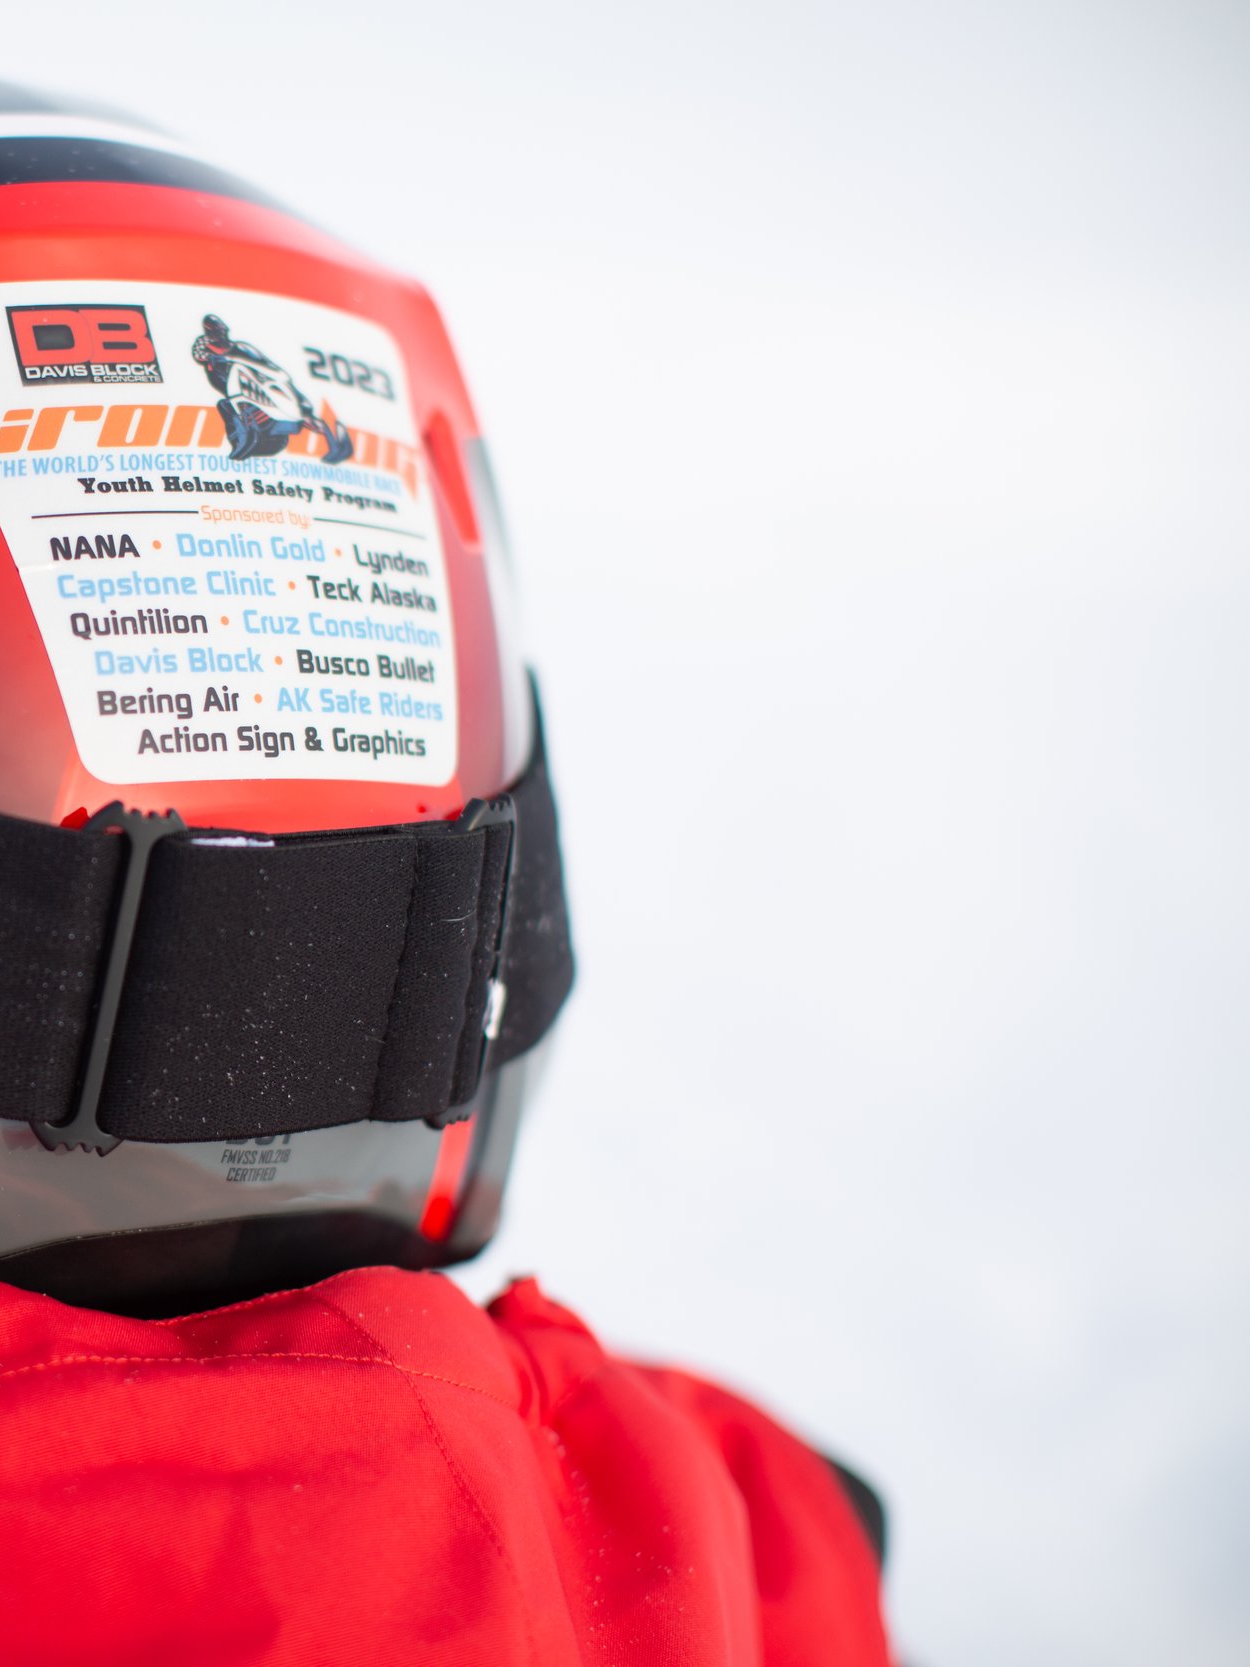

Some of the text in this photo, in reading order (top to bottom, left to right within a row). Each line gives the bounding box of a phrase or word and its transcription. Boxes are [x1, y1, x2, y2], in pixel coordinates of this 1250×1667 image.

[11, 309, 156, 366] DB
[25, 364, 158, 379] DAVIS BLOCK
[103, 375, 161, 383] CONCRETE
[303, 346, 396, 402] 2023
[32, 454, 115, 475] WORLD'S
[120, 453, 194, 471] LONGEST
[199, 455, 278, 475] TOUGHEST
[282, 460, 370, 488] SNOWMOBILE
[78, 476, 398, 513] Youth Helmet Safety Program
[201, 505, 284, 524] Sponsored
[50, 534, 140, 561] NANA
[176, 533, 326, 562] Donlin Gold
[353, 544, 430, 577] Lynden
[57, 569, 277, 603] Capstone Clinic
[306, 575, 438, 612] Teck Alaska
[70, 608, 208, 640] Quintilion
[243, 609, 442, 647] Cruz Construction
[94, 647, 264, 676] Davis Block
[296, 649, 436, 683] Busco Bullet
[97, 685, 239, 719] Bering Air
[277, 687, 444, 721] AK Safe Riders
[137, 724, 427, 761] Action Sign & Graphics
[221, 1149, 258, 1165] FMVSS
[226, 1167, 277, 1182] CERTIFIED
